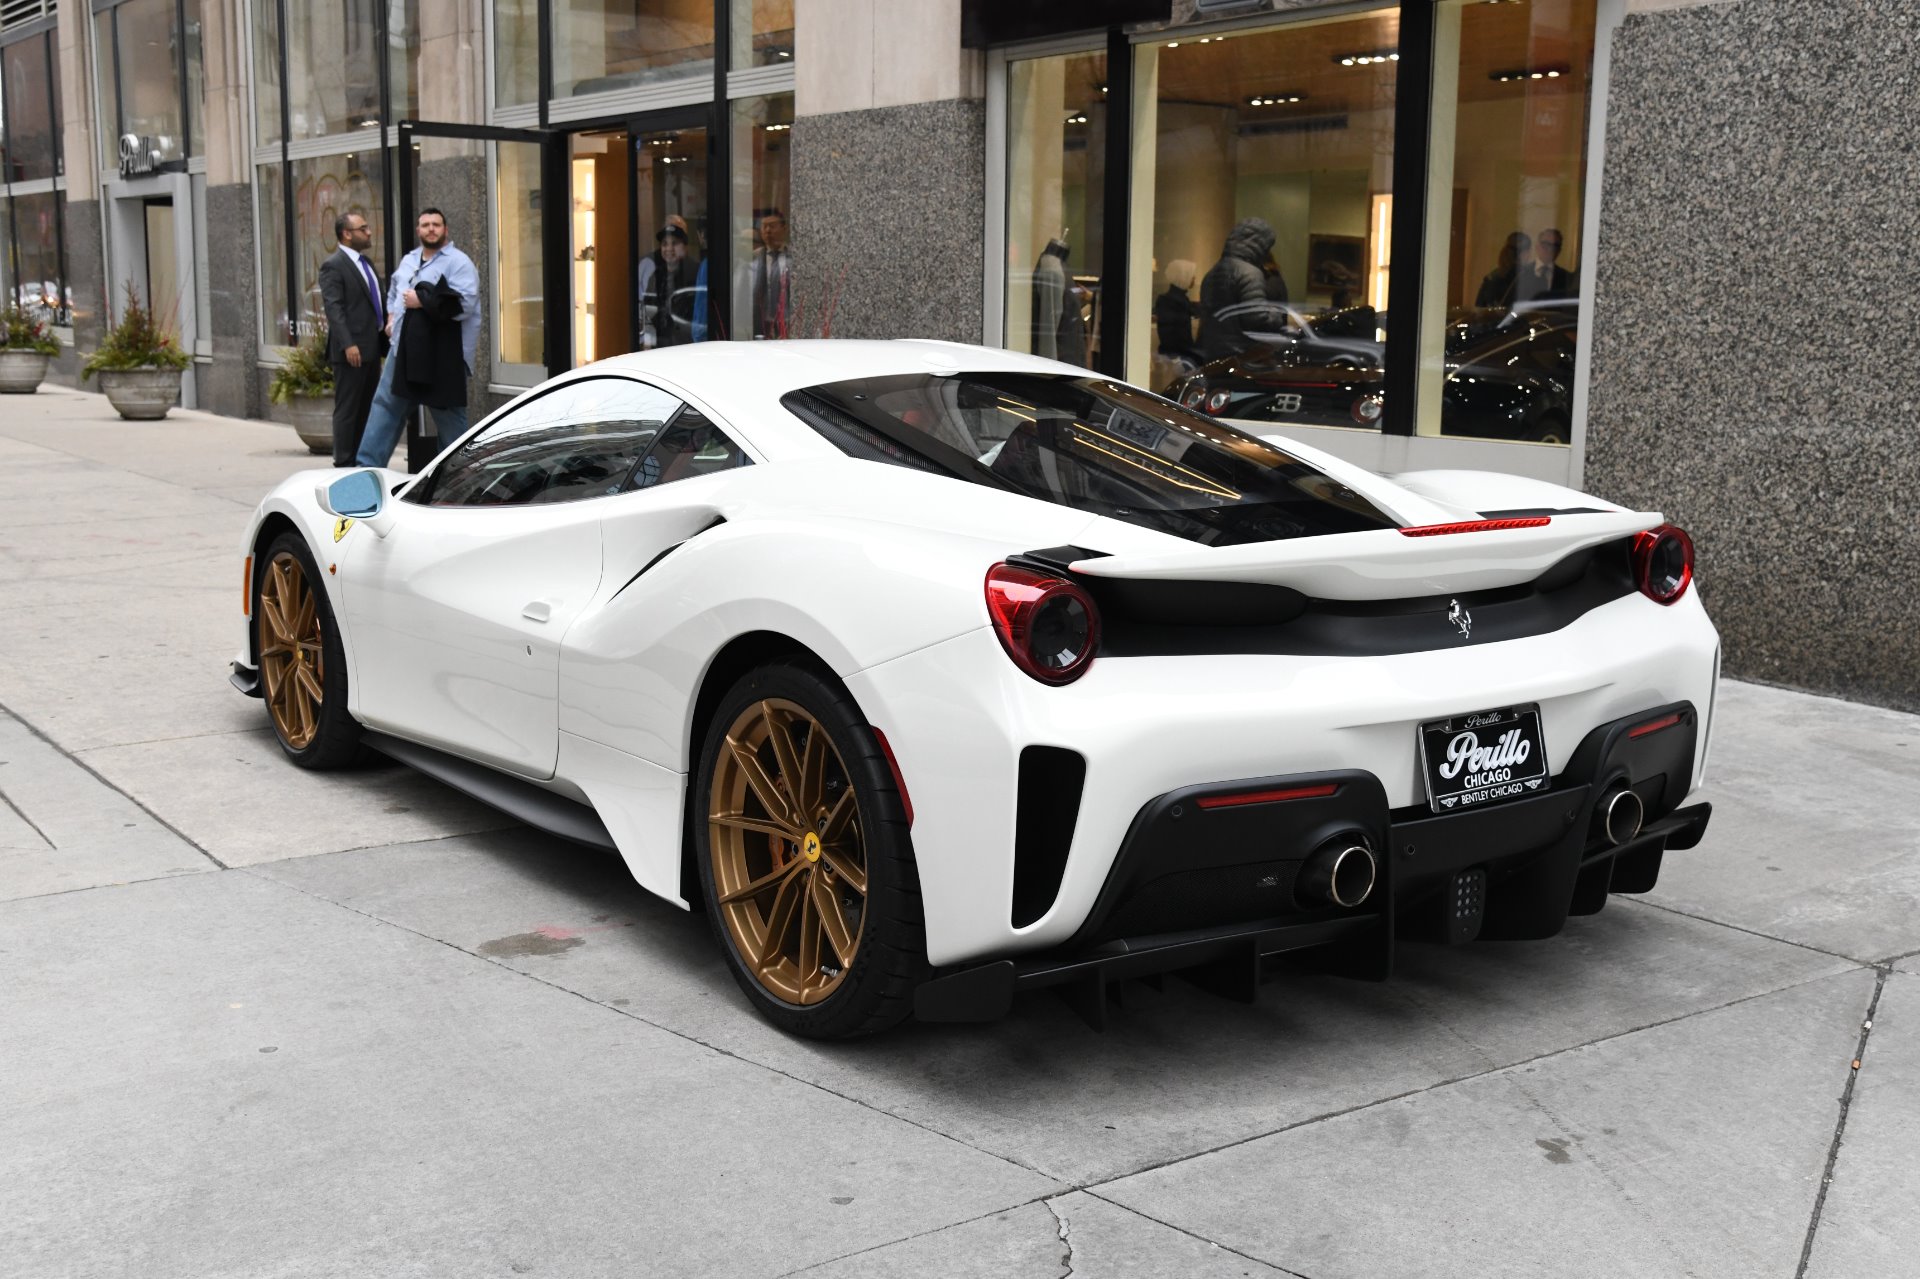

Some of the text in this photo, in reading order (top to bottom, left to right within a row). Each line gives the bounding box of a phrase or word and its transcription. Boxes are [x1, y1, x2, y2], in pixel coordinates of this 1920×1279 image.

[119, 133, 158, 175] Perillo
[1464, 712, 1502, 729] Perillo
[1439, 728, 1531, 779] Perillo
[1464, 767, 1511, 788] CHICAGO
[1461, 783, 1523, 805] BENTLEY CHICAGO
